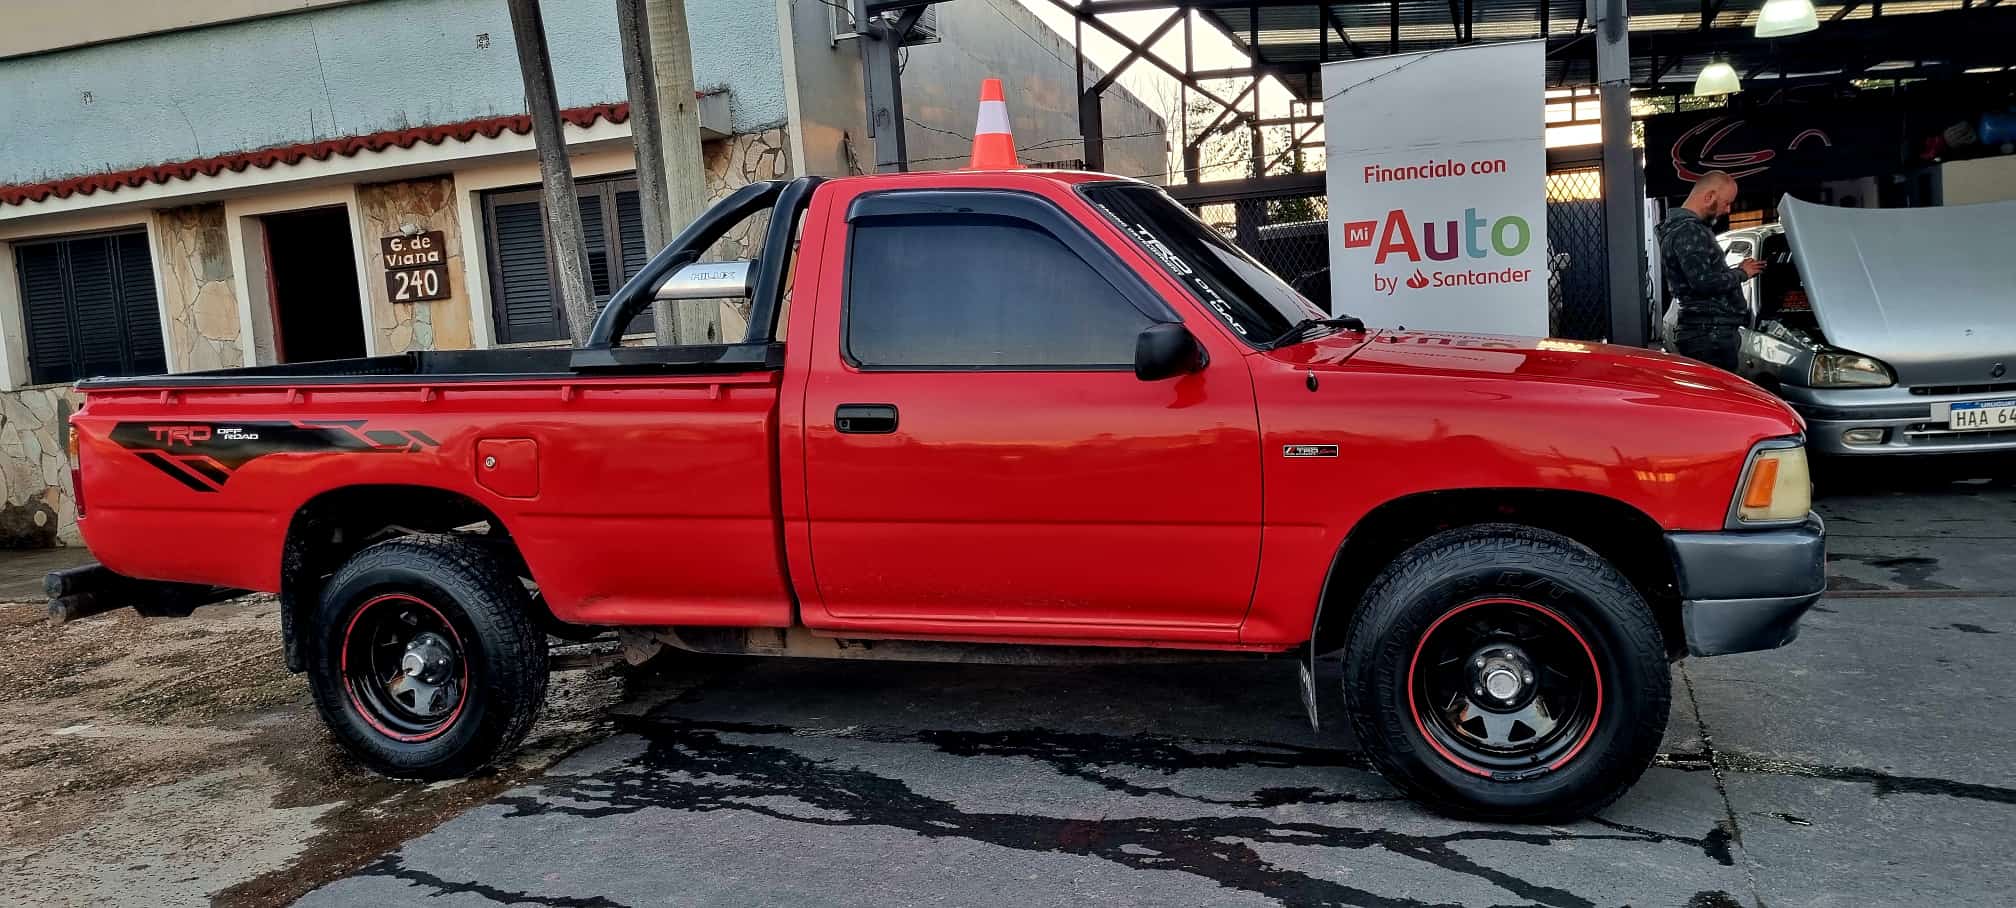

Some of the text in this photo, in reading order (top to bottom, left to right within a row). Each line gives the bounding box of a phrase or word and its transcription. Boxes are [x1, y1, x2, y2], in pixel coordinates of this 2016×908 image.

[1364, 159, 1506, 184] Financialo con
[390, 235, 431, 251] G. de
[1136, 223, 1193, 274] TRD
[1350, 208, 1531, 265] Mi Auto
[386, 251, 439, 266] Viana
[395, 269, 438, 300] 240
[1374, 267, 1531, 295] by Santander
[1957, 410, 1988, 426] HAA
[148, 426, 212, 446] TRD
